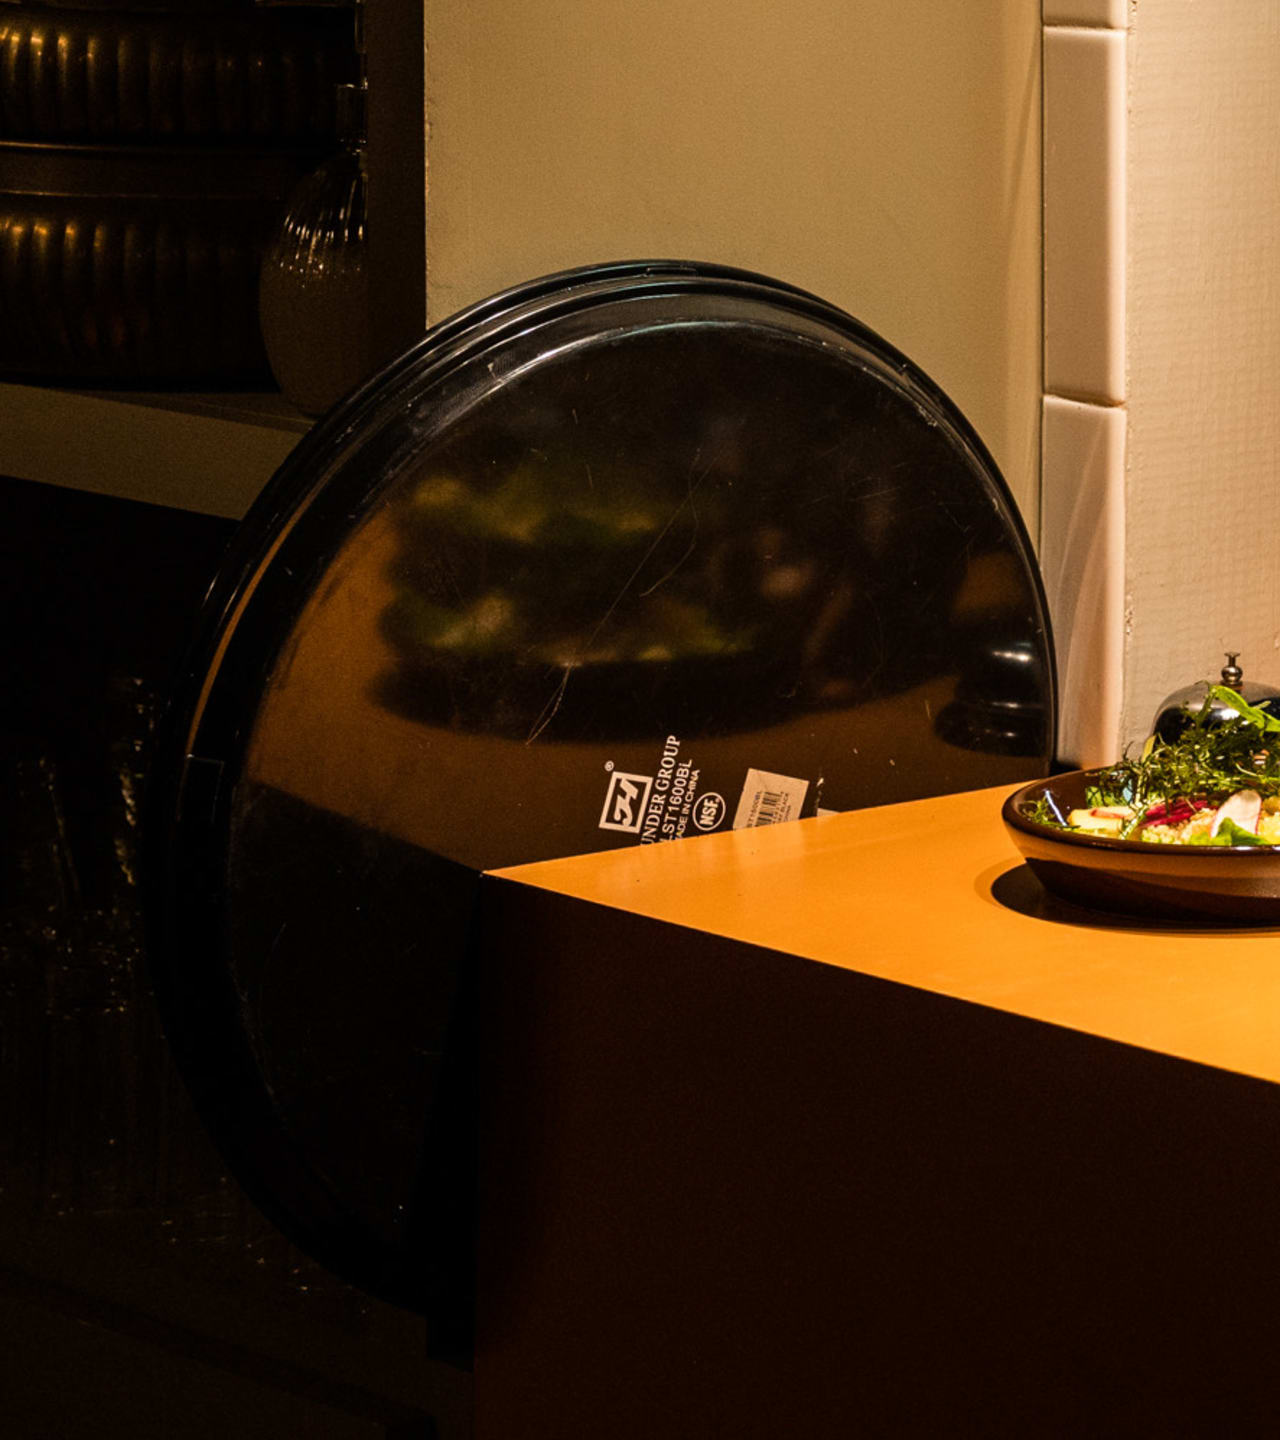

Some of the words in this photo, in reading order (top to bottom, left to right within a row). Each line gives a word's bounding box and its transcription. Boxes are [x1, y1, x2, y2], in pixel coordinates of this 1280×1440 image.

[654, 735, 681, 791] GROUP
[684, 768, 700, 802] CHINA
[699, 798, 719, 826] NSF
